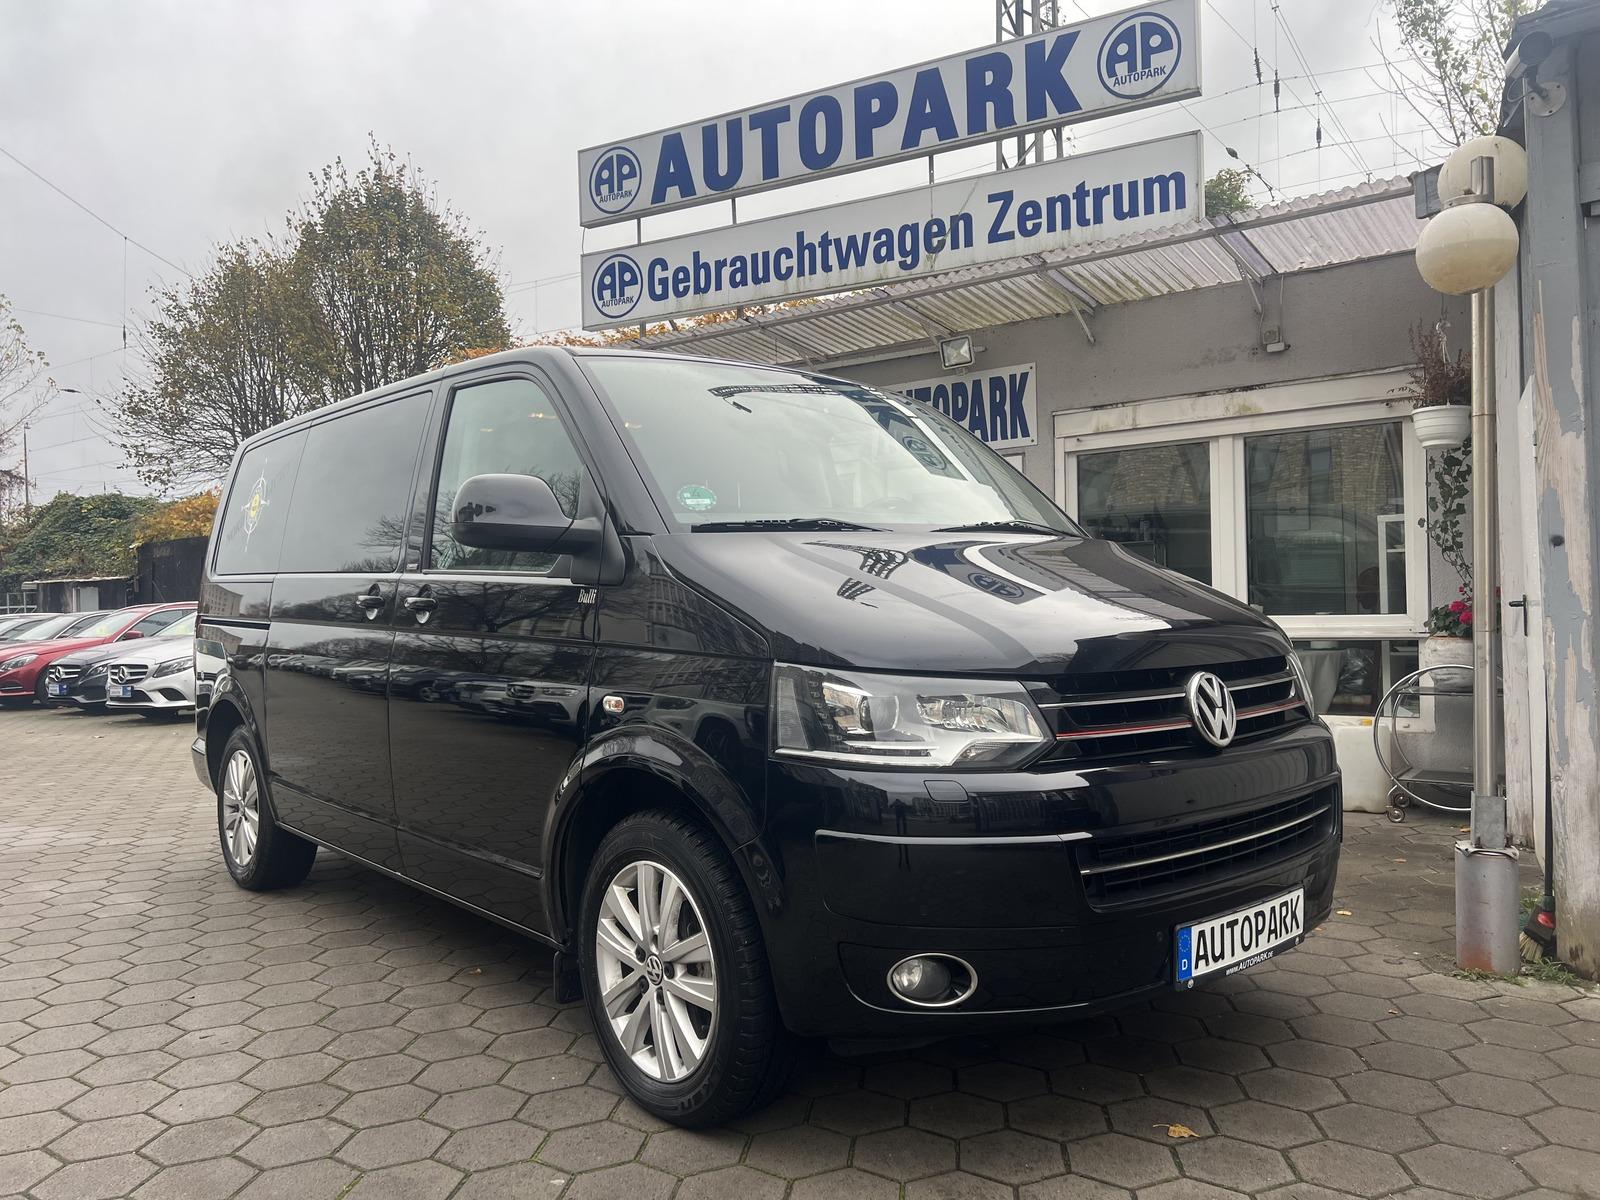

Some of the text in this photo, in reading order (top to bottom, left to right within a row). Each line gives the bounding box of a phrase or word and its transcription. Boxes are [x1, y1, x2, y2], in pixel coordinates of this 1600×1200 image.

[1113, 65, 1167, 88] AUTOPARK
[650, 30, 1083, 205] AUTOPARK
[599, 189, 633, 203] AUTOPARK
[647, 170, 1187, 302] Gebrauchtwagen Zentrum
[601, 296, 634, 308] AUTOPARK
[577, 588, 597, 604] Bulli
[1194, 895, 1300, 970] AUTOPARK
[1181, 959, 1188, 970] D
